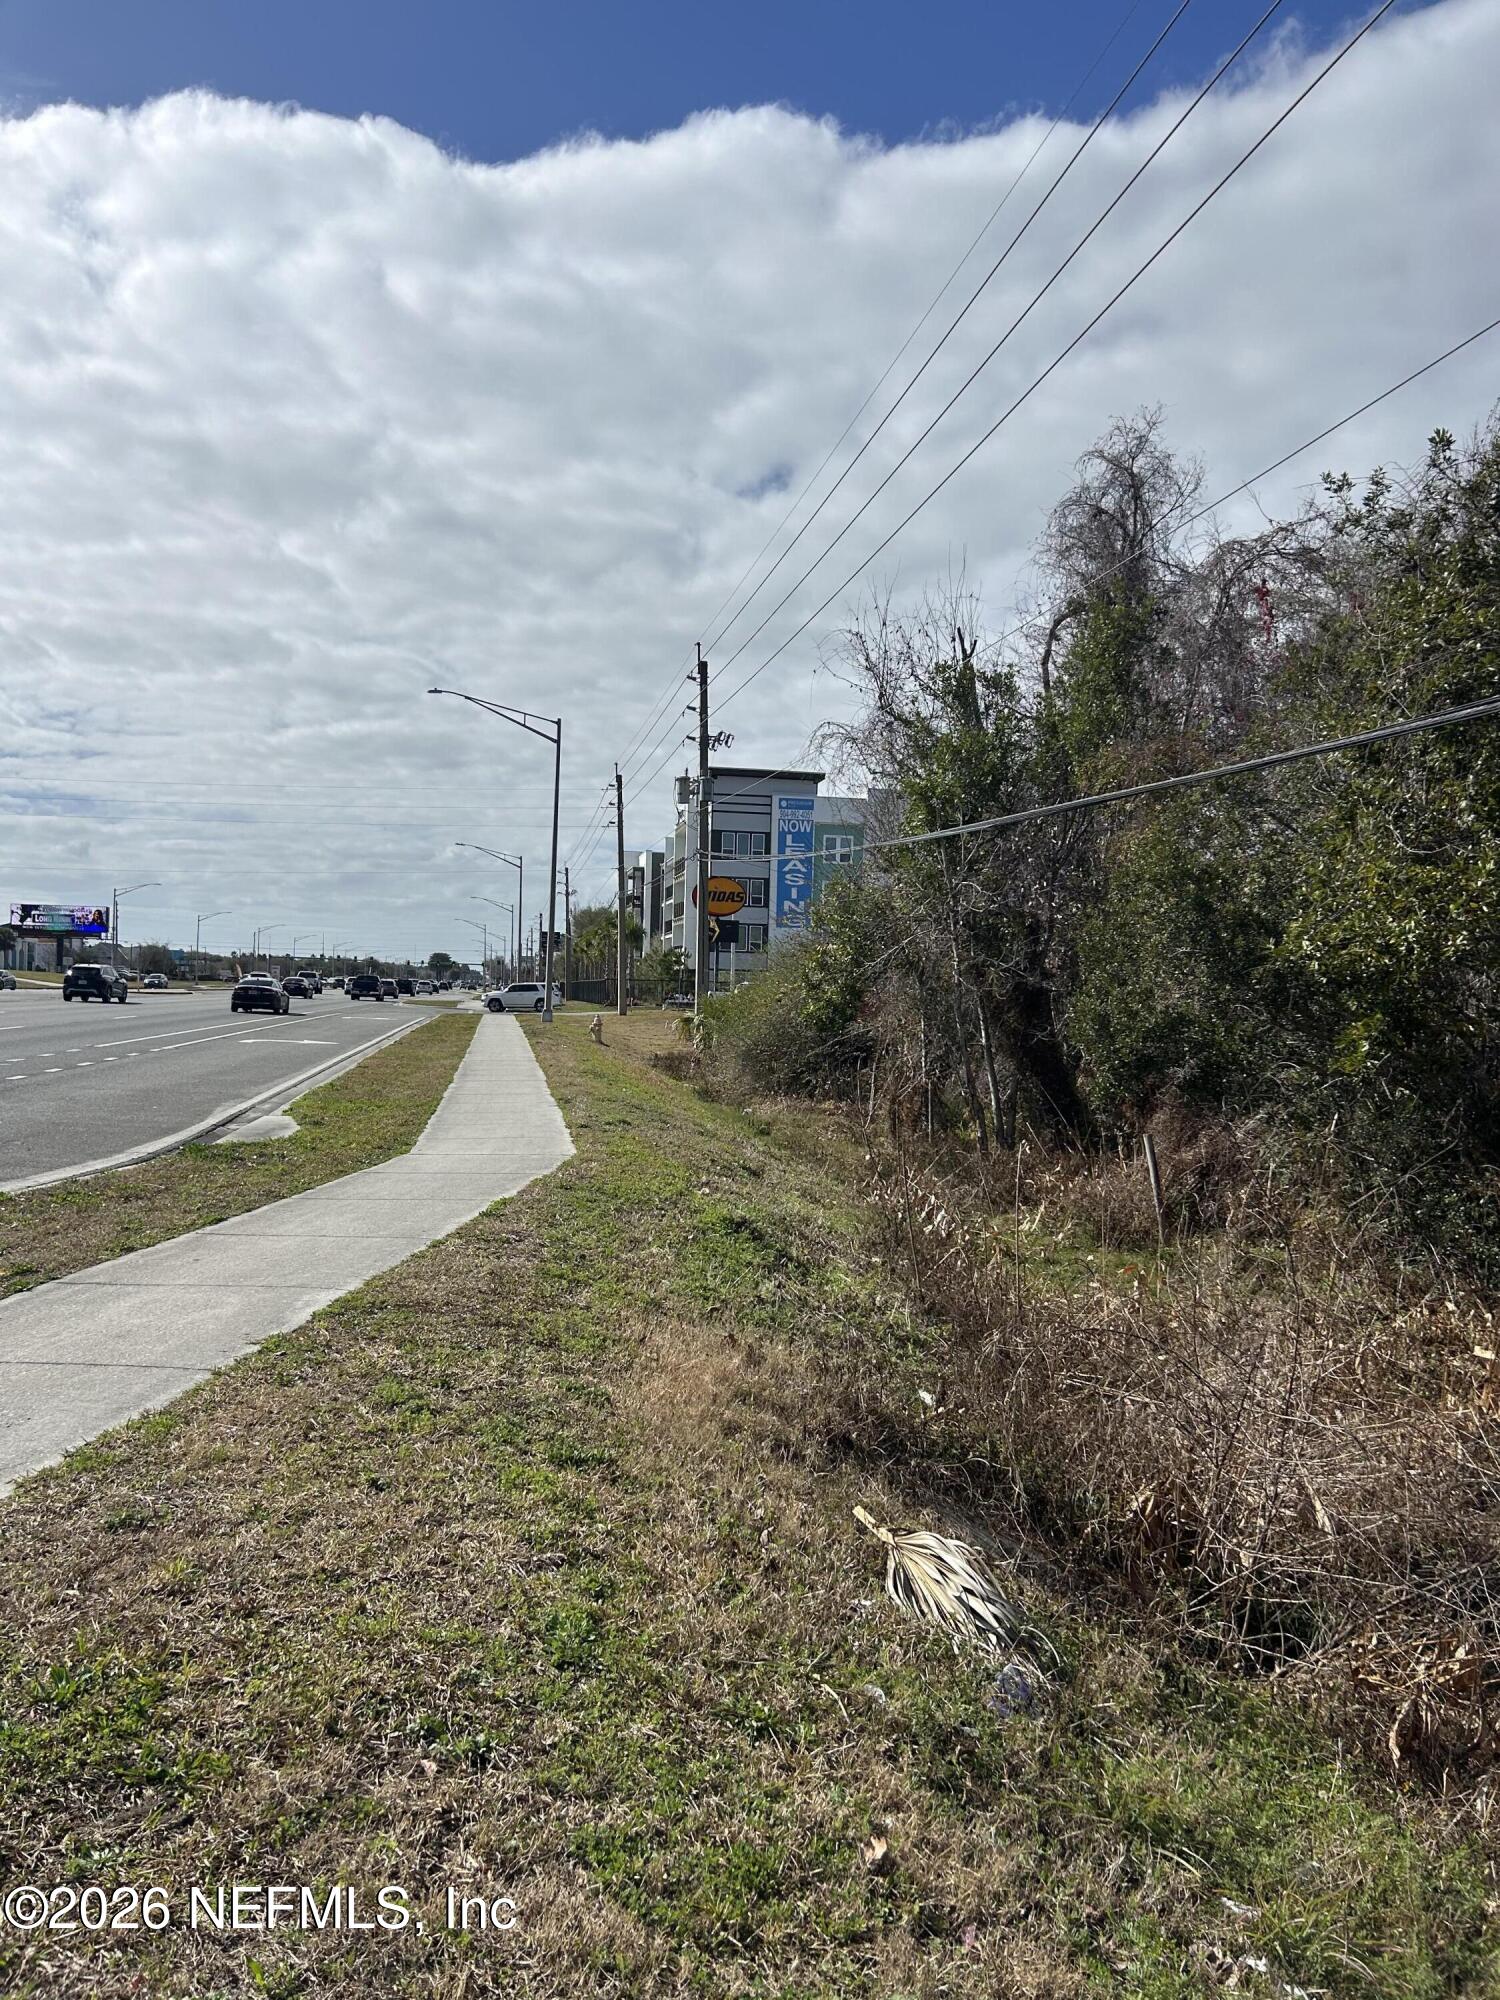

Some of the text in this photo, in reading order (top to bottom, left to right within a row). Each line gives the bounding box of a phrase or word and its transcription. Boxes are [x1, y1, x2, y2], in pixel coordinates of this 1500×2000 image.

[779, 820, 813, 832] NOW
[782, 833, 807, 927] LEASING
[708, 891, 745, 903] IDAS
